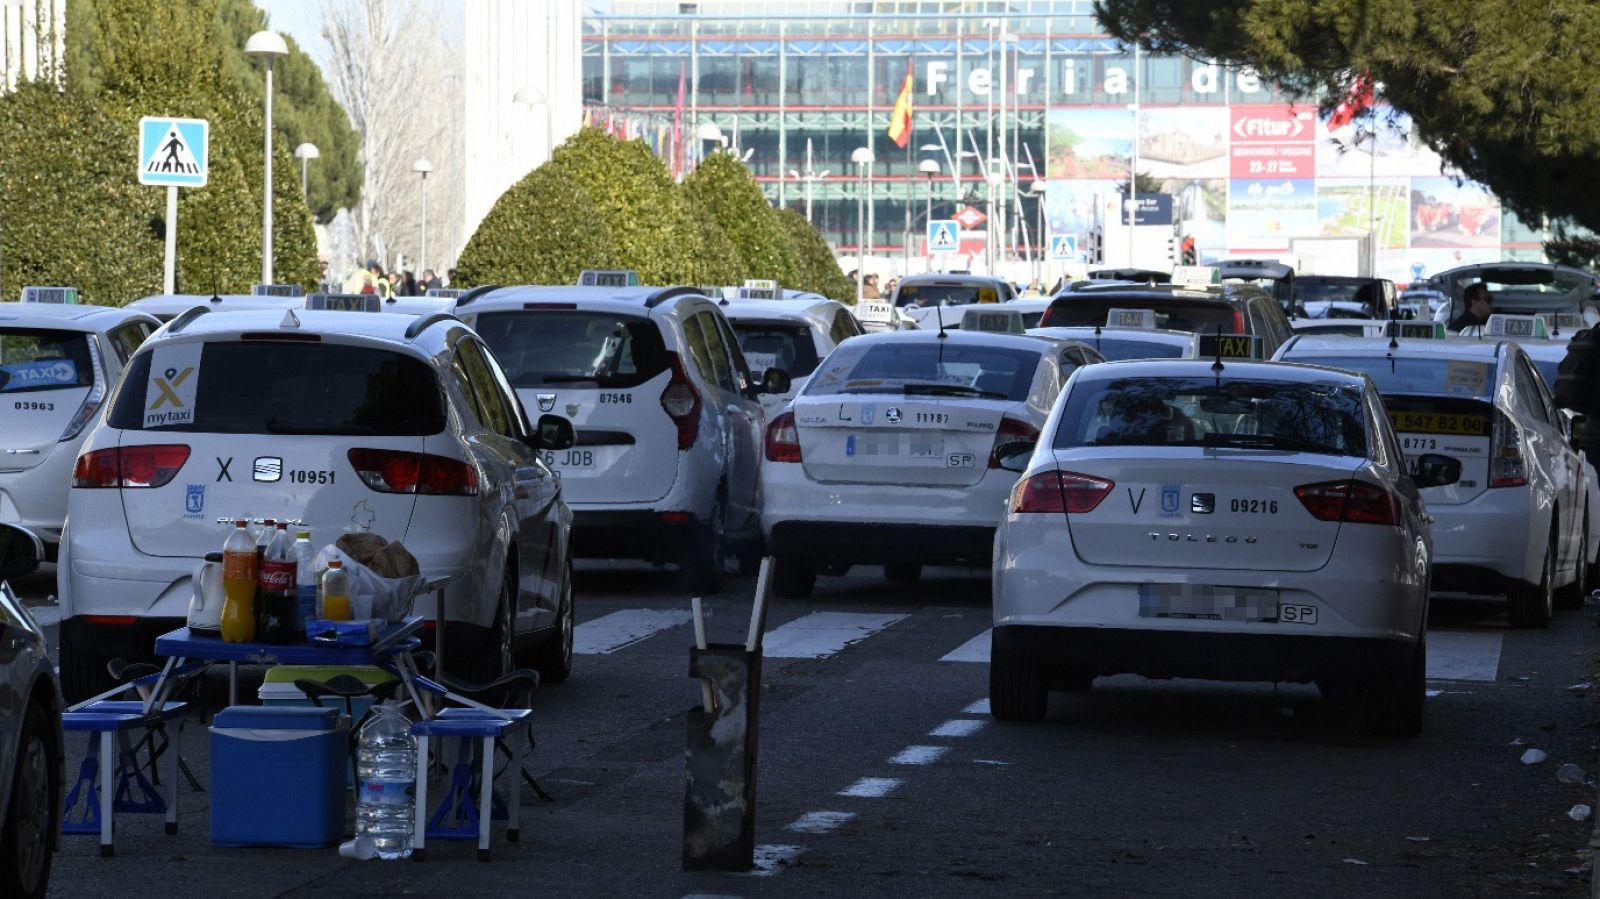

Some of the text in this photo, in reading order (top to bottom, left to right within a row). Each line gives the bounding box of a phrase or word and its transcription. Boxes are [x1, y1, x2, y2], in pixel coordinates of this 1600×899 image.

[926, 59, 1127, 95] Feria
[1246, 118, 1291, 136] Fitur
[599, 272, 625, 286] TAXI
[39, 289, 64, 303] TAXI
[327, 298, 364, 310] TAXI
[1120, 313, 1143, 326] TAXI
[1405, 325, 1432, 337] TAXI
[1506, 319, 1531, 335] TAXI
[1215, 337, 1250, 356] TAXI
[16, 367, 57, 381] TAXI
[600, 393, 632, 403] 07546
[14, 401, 54, 412] 03963
[147, 409, 191, 424] mytaxi
[1403, 415, 1432, 430] 547
[1438, 416, 1457, 431] 82
[1462, 416, 1481, 431] 00
[1397, 437, 1436, 450] 8773
[561, 451, 592, 466] JDB
[949, 456, 971, 466] SP
[216, 457, 233, 482] X
[289, 470, 335, 484] 10951
[1127, 487, 1146, 514] V
[1230, 498, 1278, 514] 09216
[1148, 532, 1257, 543] TOLEDO
[1284, 606, 1313, 621] SP
